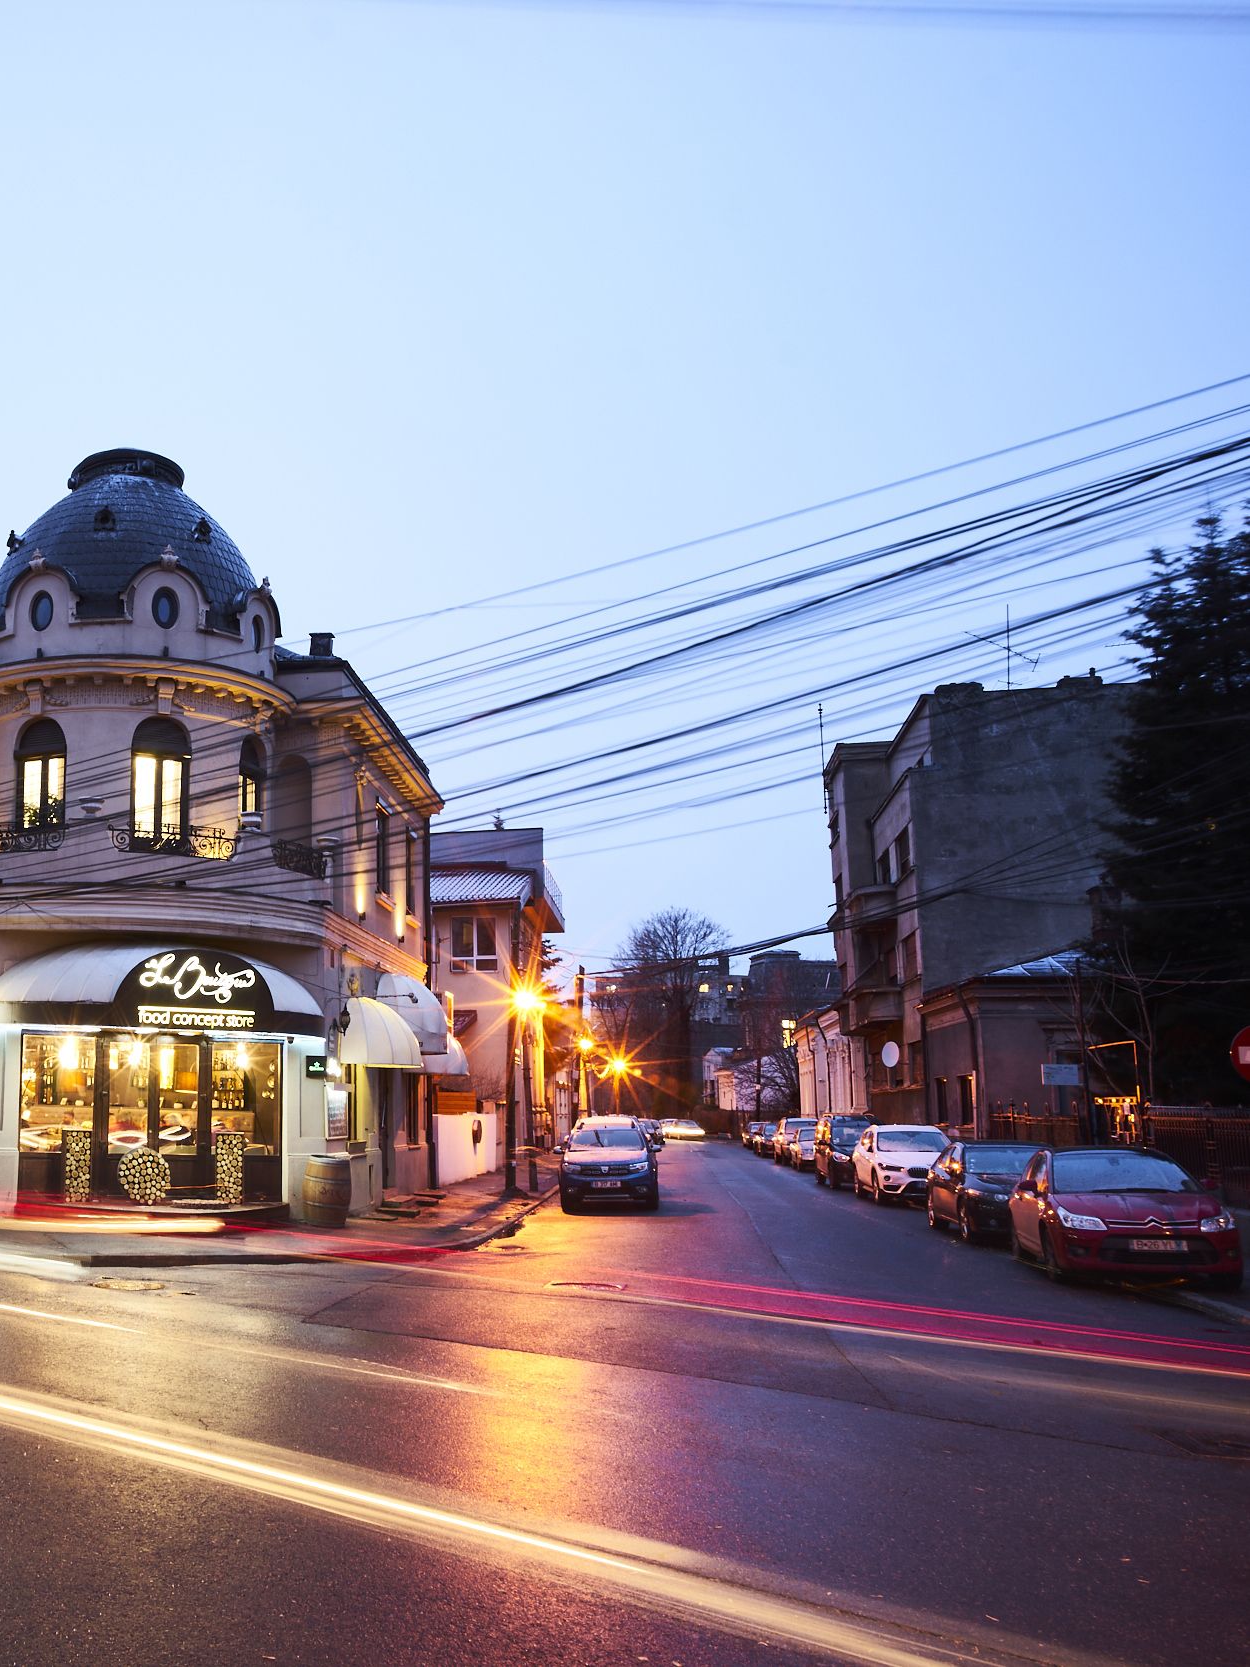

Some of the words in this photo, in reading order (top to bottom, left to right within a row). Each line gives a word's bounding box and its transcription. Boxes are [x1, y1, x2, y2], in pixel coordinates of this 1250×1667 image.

[138, 1010, 170, 1025] food
[172, 1013, 225, 1029] concept
[226, 1014, 255, 1028] store
